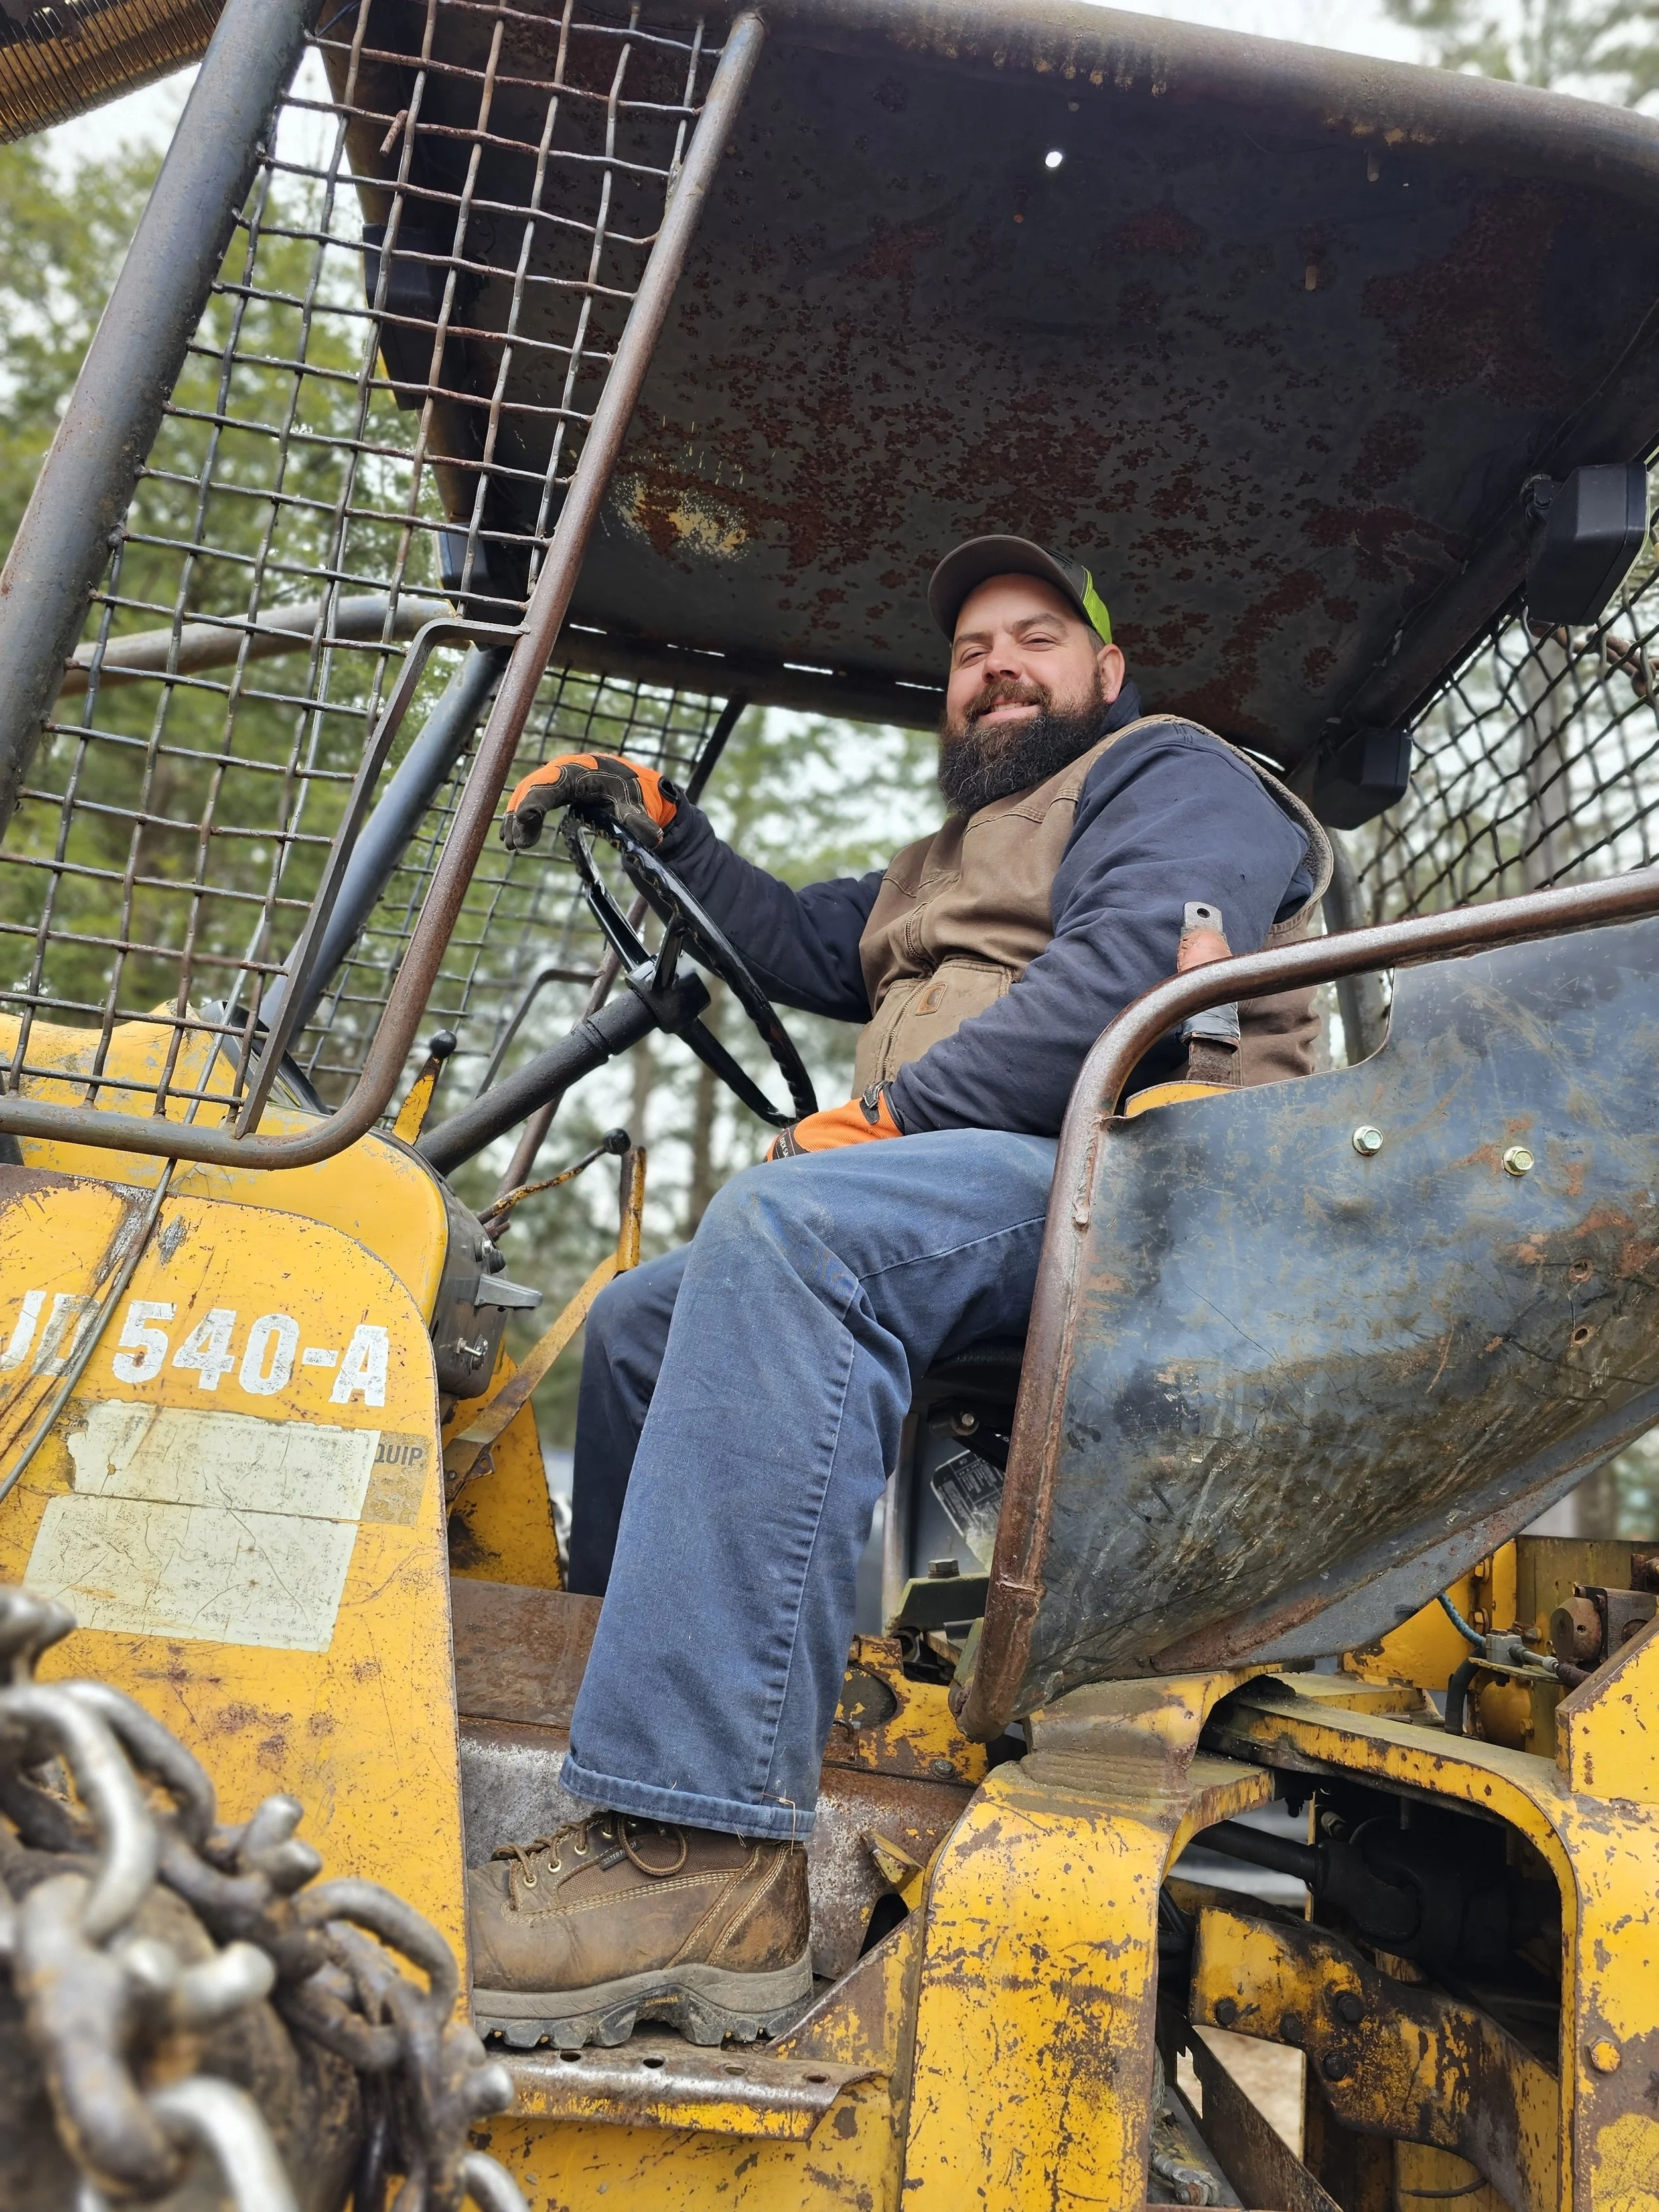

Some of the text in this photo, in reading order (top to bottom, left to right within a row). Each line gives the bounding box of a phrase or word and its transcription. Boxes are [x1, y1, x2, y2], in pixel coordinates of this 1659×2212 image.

[0, 1289, 390, 1407] JD 540-A
[602, 1840, 638, 1866] WATERPOF
